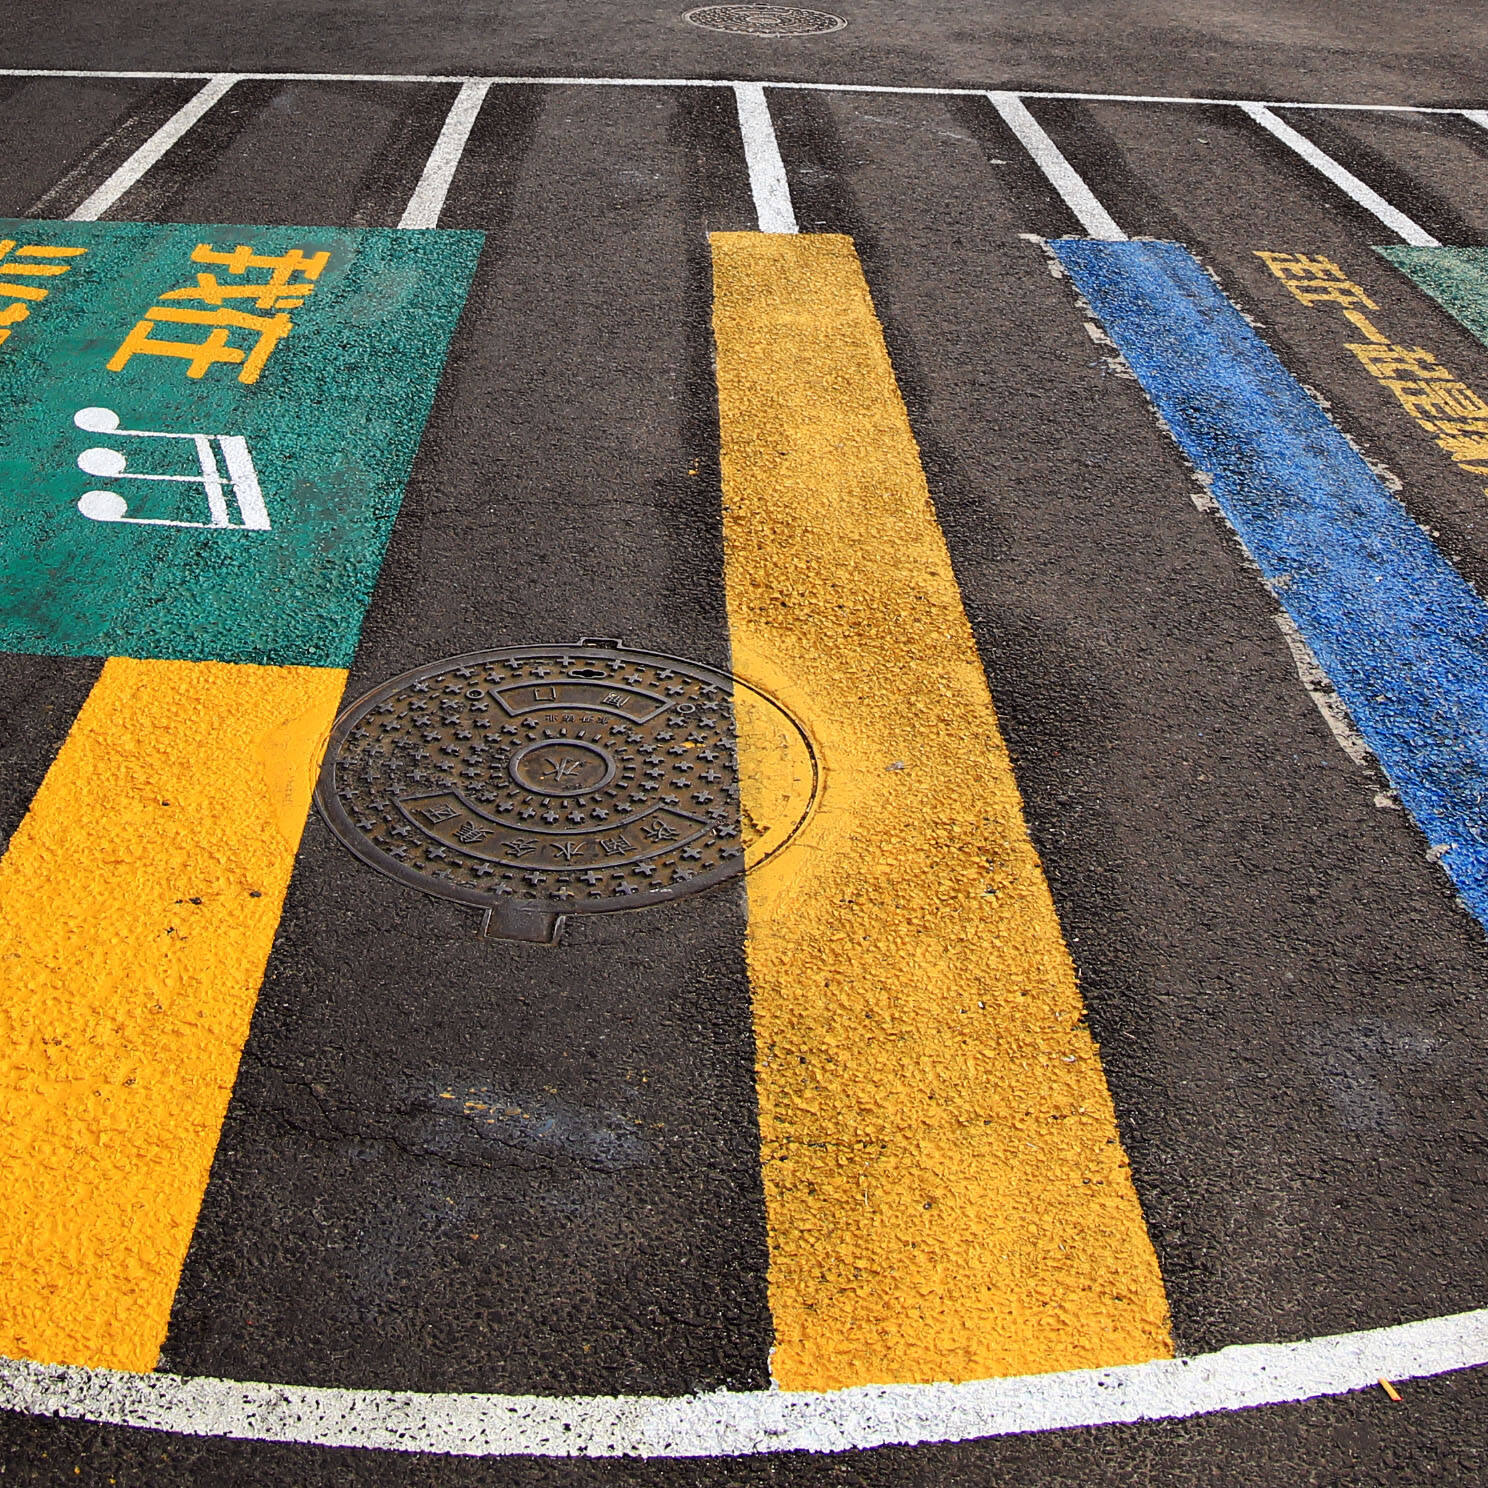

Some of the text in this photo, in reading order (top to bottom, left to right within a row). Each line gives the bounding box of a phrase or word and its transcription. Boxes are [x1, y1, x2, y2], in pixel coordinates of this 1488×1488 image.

[105, 241, 332, 386] 我在
[421, 802, 683, 863] 济南水务集团
